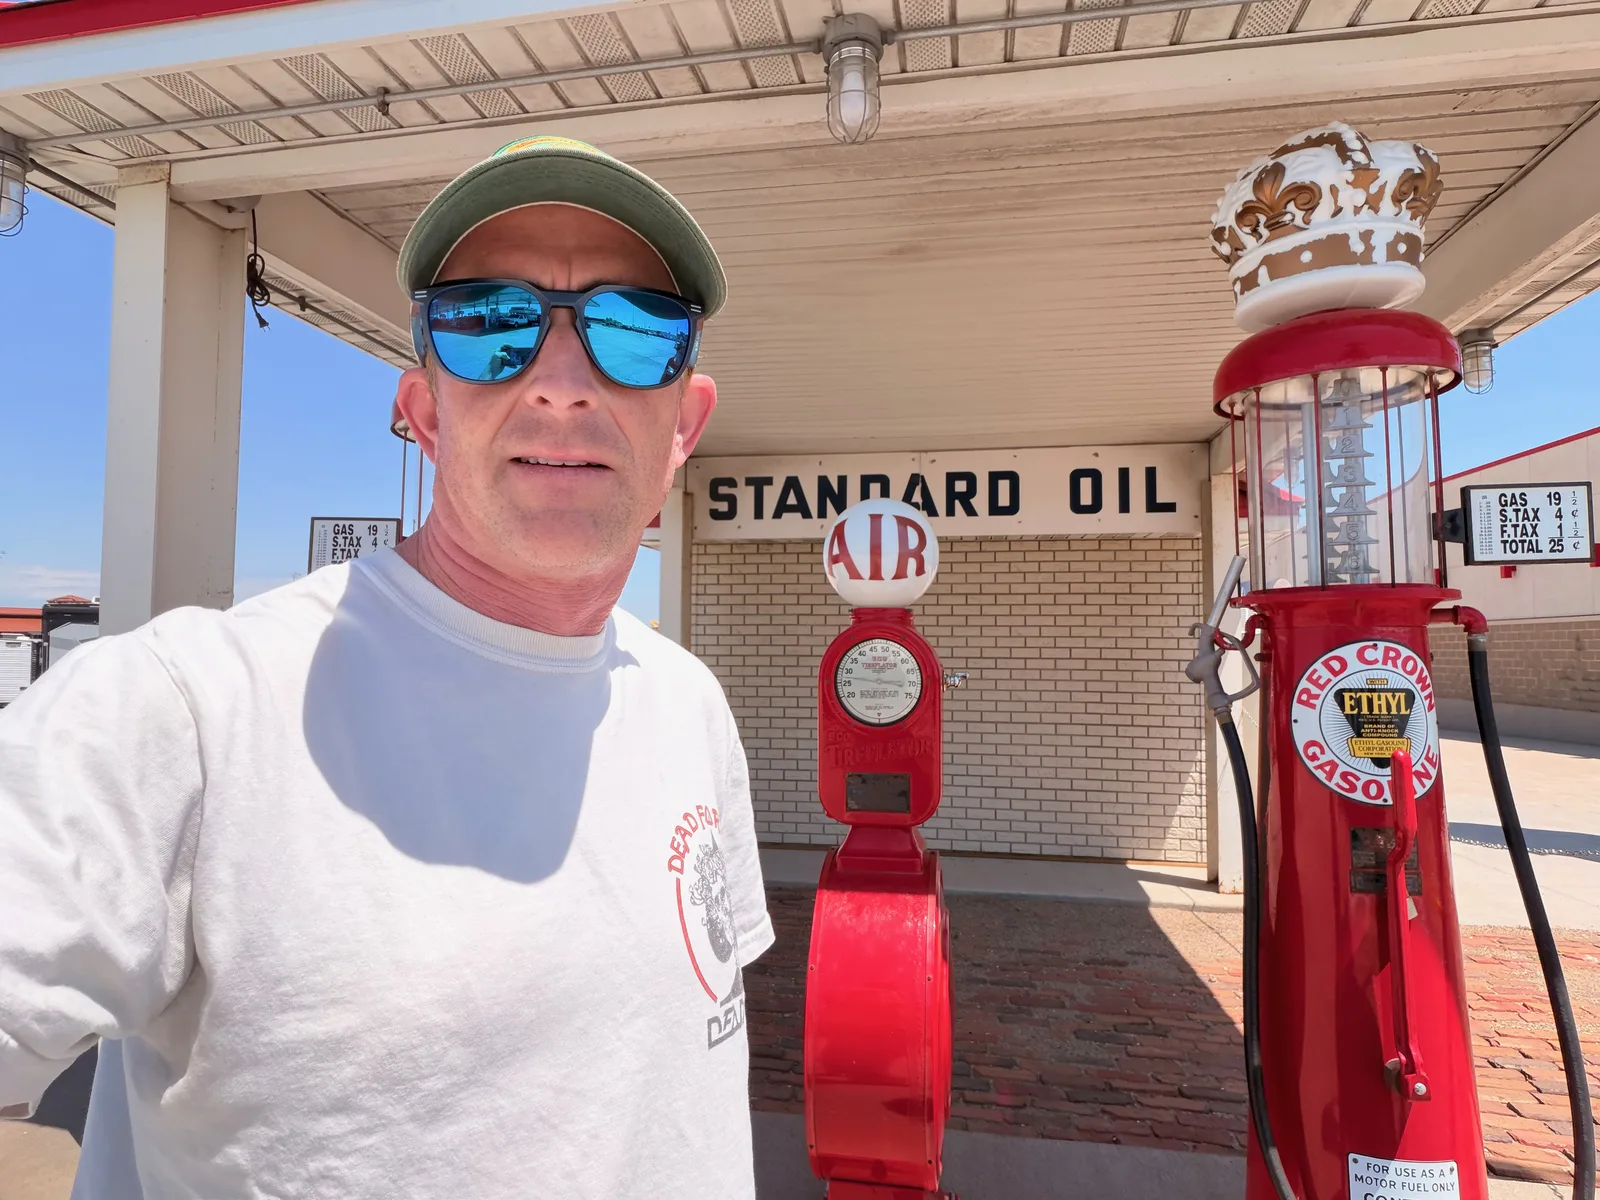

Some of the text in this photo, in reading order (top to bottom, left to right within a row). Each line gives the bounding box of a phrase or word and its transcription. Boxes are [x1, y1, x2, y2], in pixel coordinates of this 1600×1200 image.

[1341, 437, 1355, 454] 2
[1344, 465, 1357, 482] 3
[1069, 466, 1177, 515] OIL
[1343, 494, 1359, 511] 4
[1498, 492, 1528, 508] GAS
[1547, 491, 1561, 506] 19
[1499, 507, 1541, 523] S.TAX
[1554, 507, 1563, 521] 4
[333, 524, 355, 536] GAS
[367, 524, 378, 536] 19
[1346, 523, 1360, 541] 5
[1500, 523, 1540, 539] F.TAX
[1556, 522, 1563, 537] 1
[332, 536, 362, 548] S.TAX
[371, 536, 378, 549] 4
[828, 513, 928, 581] AIR
[1501, 539, 1544, 554] TOTAL
[1549, 539, 1564, 554] 25
[331, 548, 360, 560] F.TAX
[1348, 553, 1361, 570] 6
[850, 657, 859, 665] 35
[844, 667, 853, 675] 30
[1296, 644, 1435, 713] RED CROWN
[1342, 692, 1411, 715] ETHYL
[1302, 739, 1438, 801] GASONE
[668, 812, 699, 875] DEAD
[1366, 1162, 1445, 1178] FOR USE AS A
[1354, 1173, 1455, 1192] MOTOR FUEL ONLY
